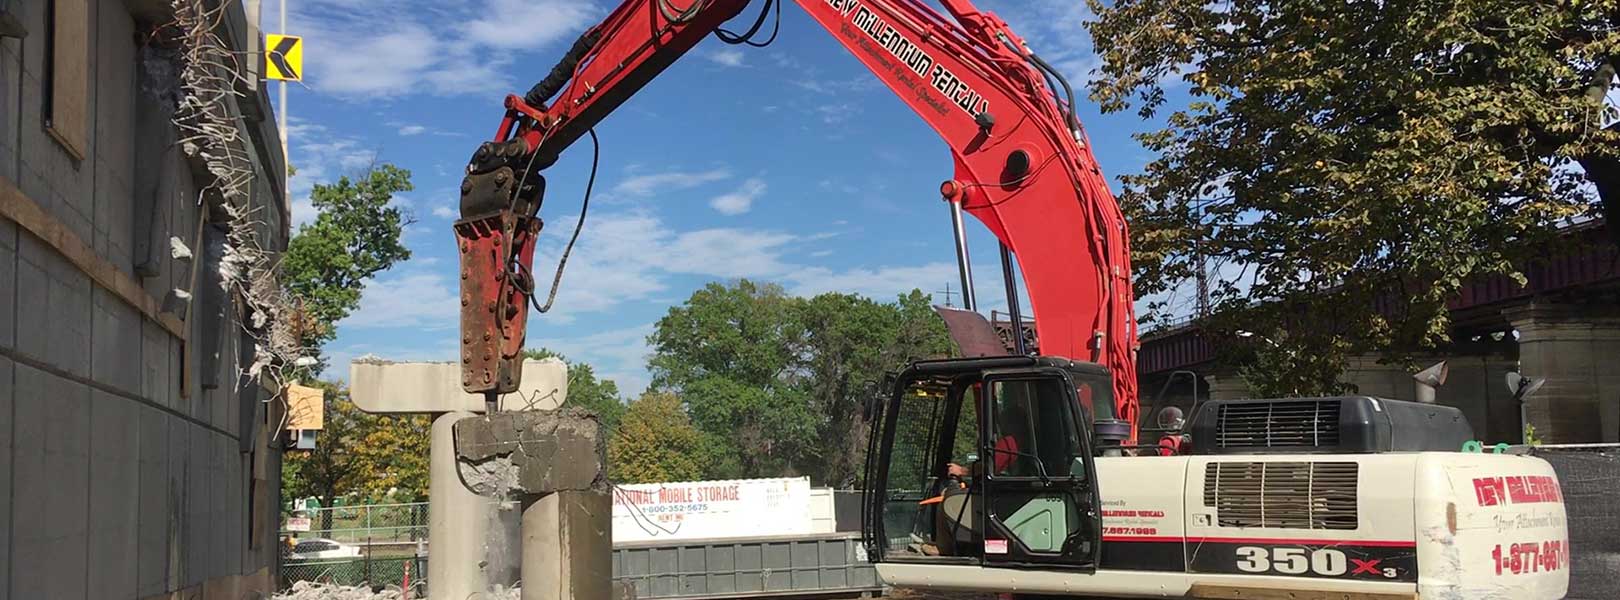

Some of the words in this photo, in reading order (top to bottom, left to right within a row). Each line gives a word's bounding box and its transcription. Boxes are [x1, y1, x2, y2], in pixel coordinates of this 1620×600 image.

[852, 4, 933, 79] MILLENNIUM
[659, 487, 693, 504] MOBILE
[697, 485, 740, 502] STORAGE
[1472, 476, 1506, 506] NEW
[641, 503, 708, 514] 1-800-352-5675
[1235, 546, 1347, 576] 350
